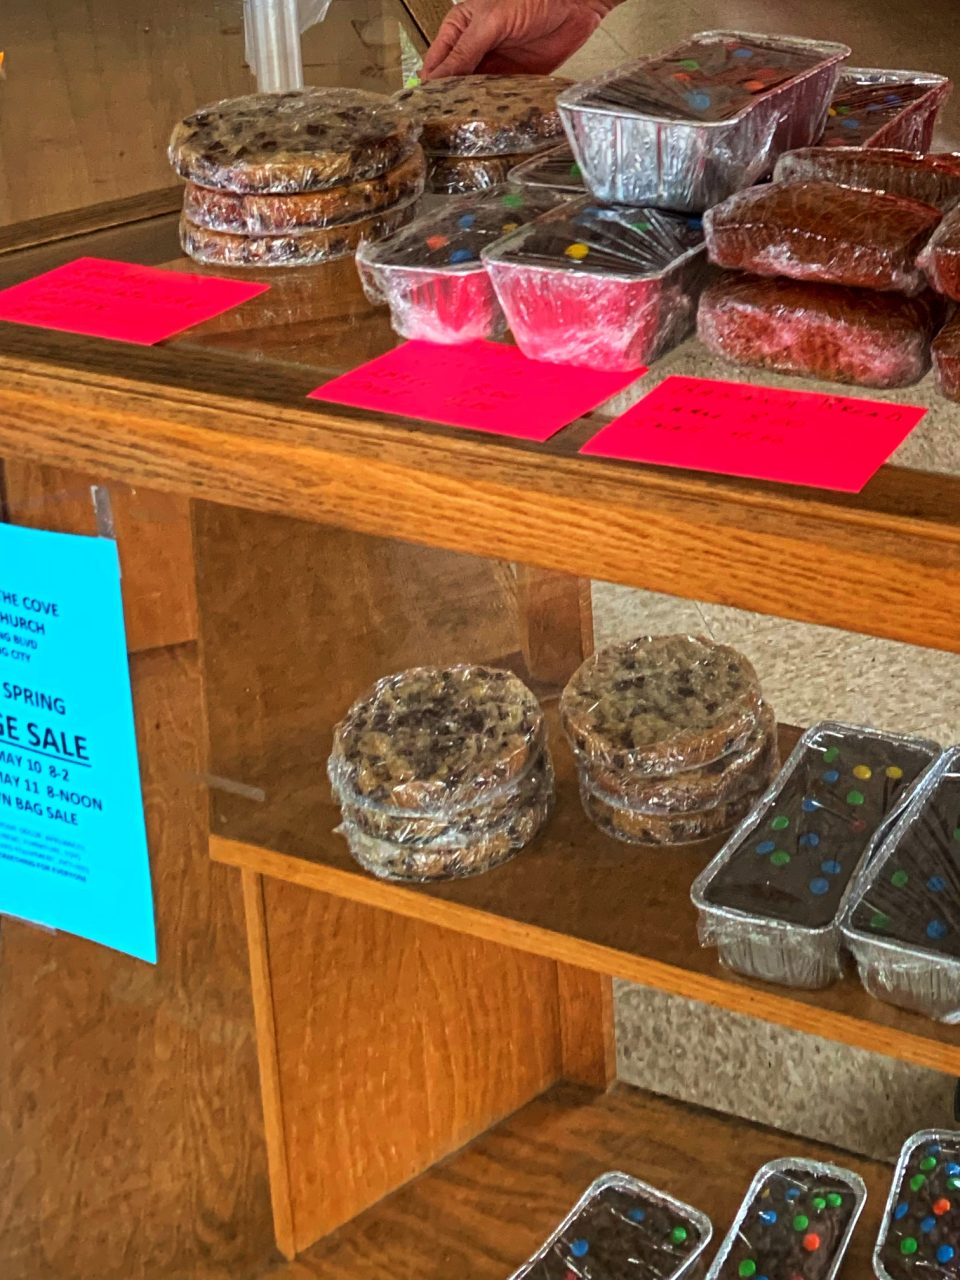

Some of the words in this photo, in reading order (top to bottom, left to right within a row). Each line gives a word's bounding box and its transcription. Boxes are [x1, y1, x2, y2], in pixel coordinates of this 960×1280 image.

[22, 596, 59, 617] COVE
[11, 649, 31, 662] CITY
[3, 681, 66, 715] SPRING
[27, 722, 89, 760] SALE
[28, 759, 42, 773] 10
[49, 765, 70, 782] 8-2
[25, 779, 39, 794] 11
[47, 785, 103, 811] 8-NOON
[15, 796, 43, 816] BAG
[46, 806, 78, 826] SALE
